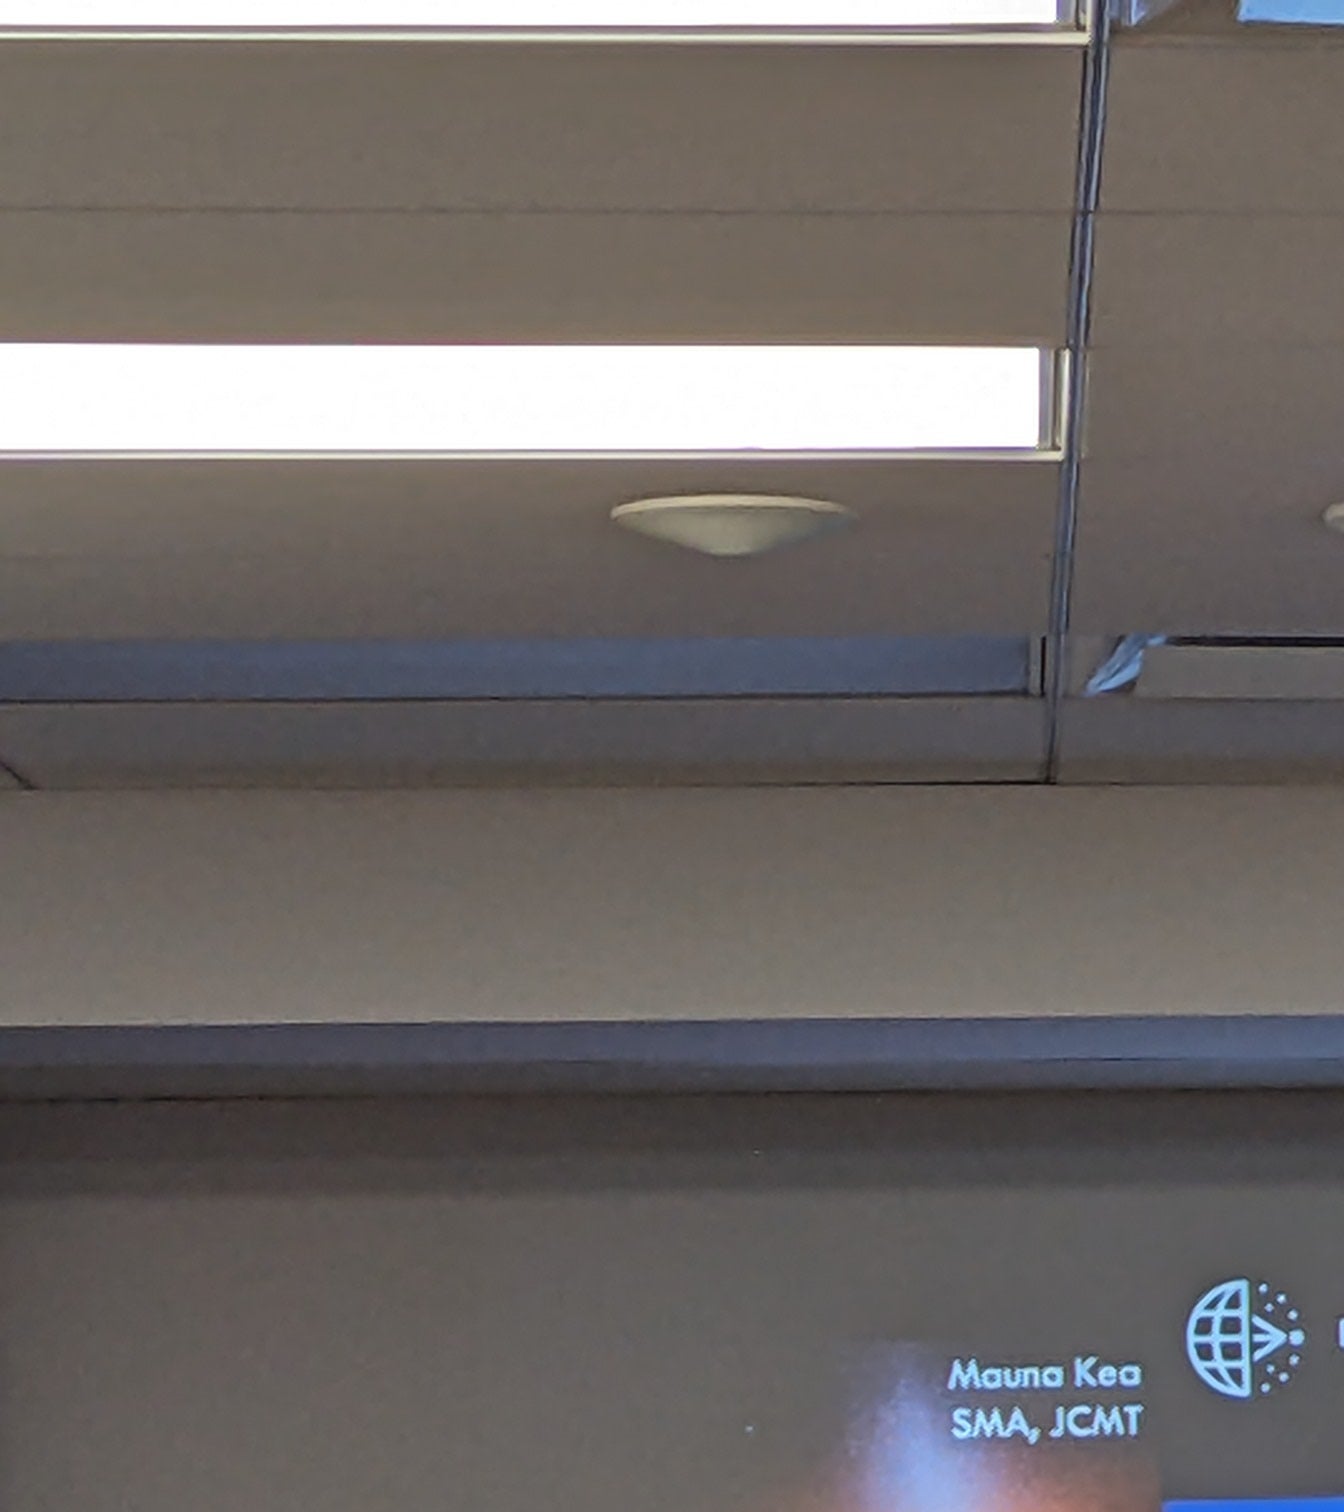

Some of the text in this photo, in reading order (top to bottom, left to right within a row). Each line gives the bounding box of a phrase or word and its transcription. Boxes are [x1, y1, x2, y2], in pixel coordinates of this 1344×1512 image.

[947, 1355, 1142, 1390] Mauna Kea
[951, 1403, 1144, 1445] SMA, JCMT
